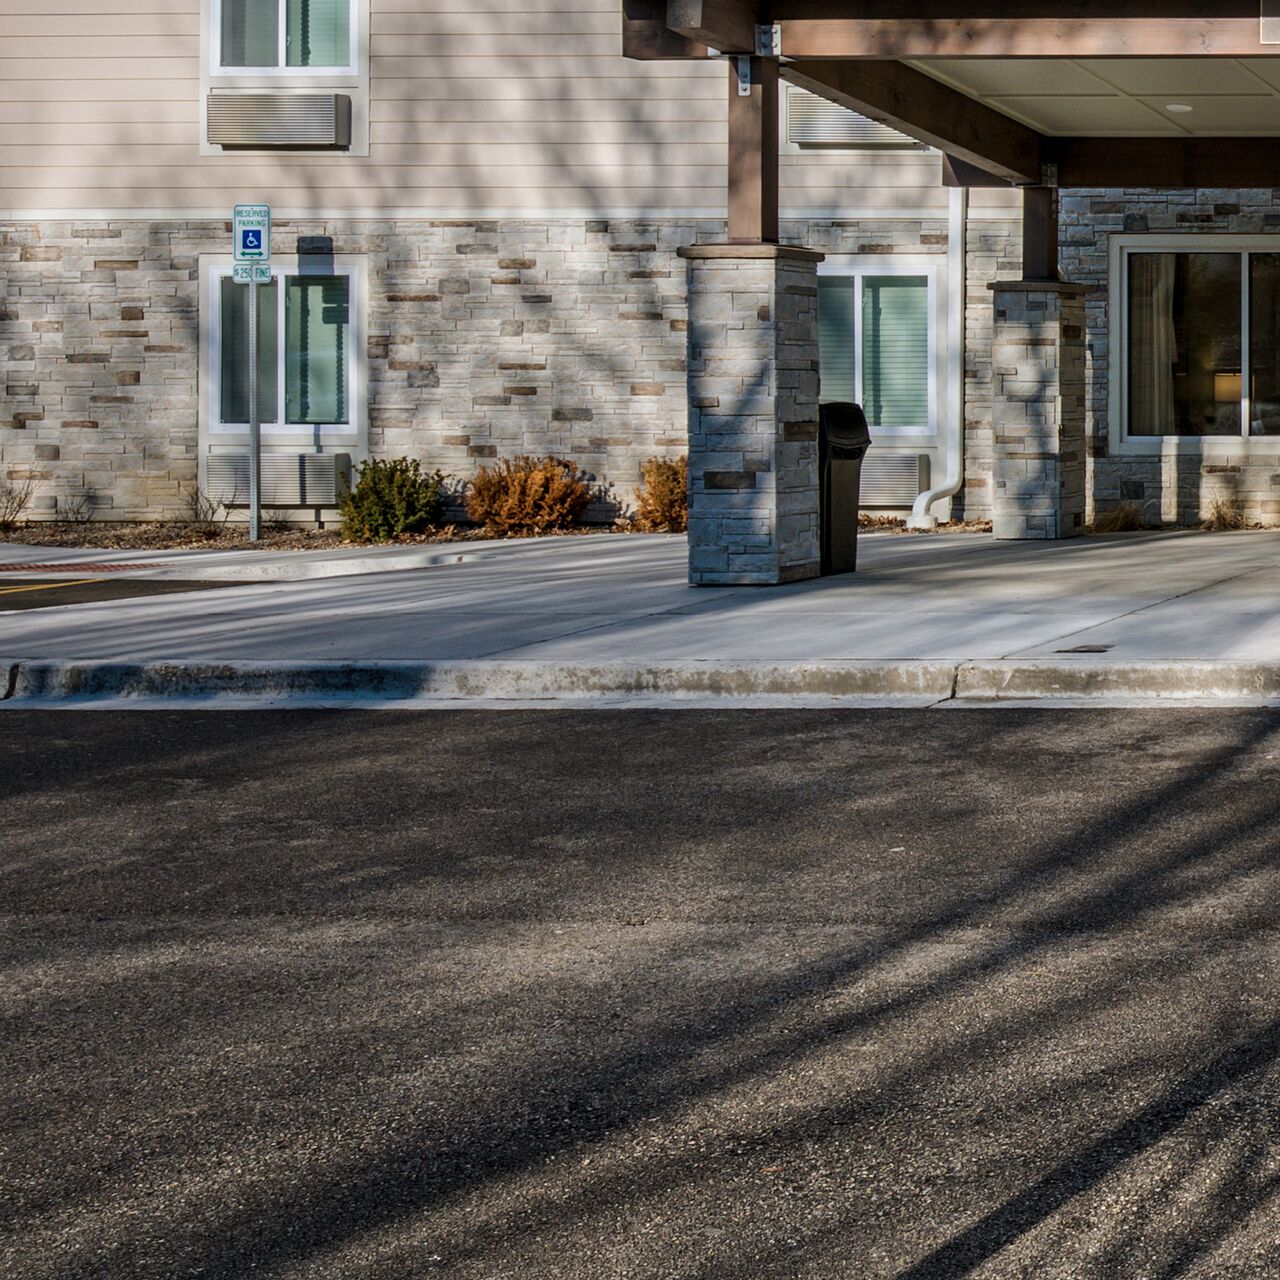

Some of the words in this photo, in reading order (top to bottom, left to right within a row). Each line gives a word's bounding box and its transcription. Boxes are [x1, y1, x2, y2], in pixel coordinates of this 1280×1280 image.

[235, 209, 268, 218] RESERVED
[238, 219, 266, 227] PARKING
[255, 267, 270, 278] FINE
